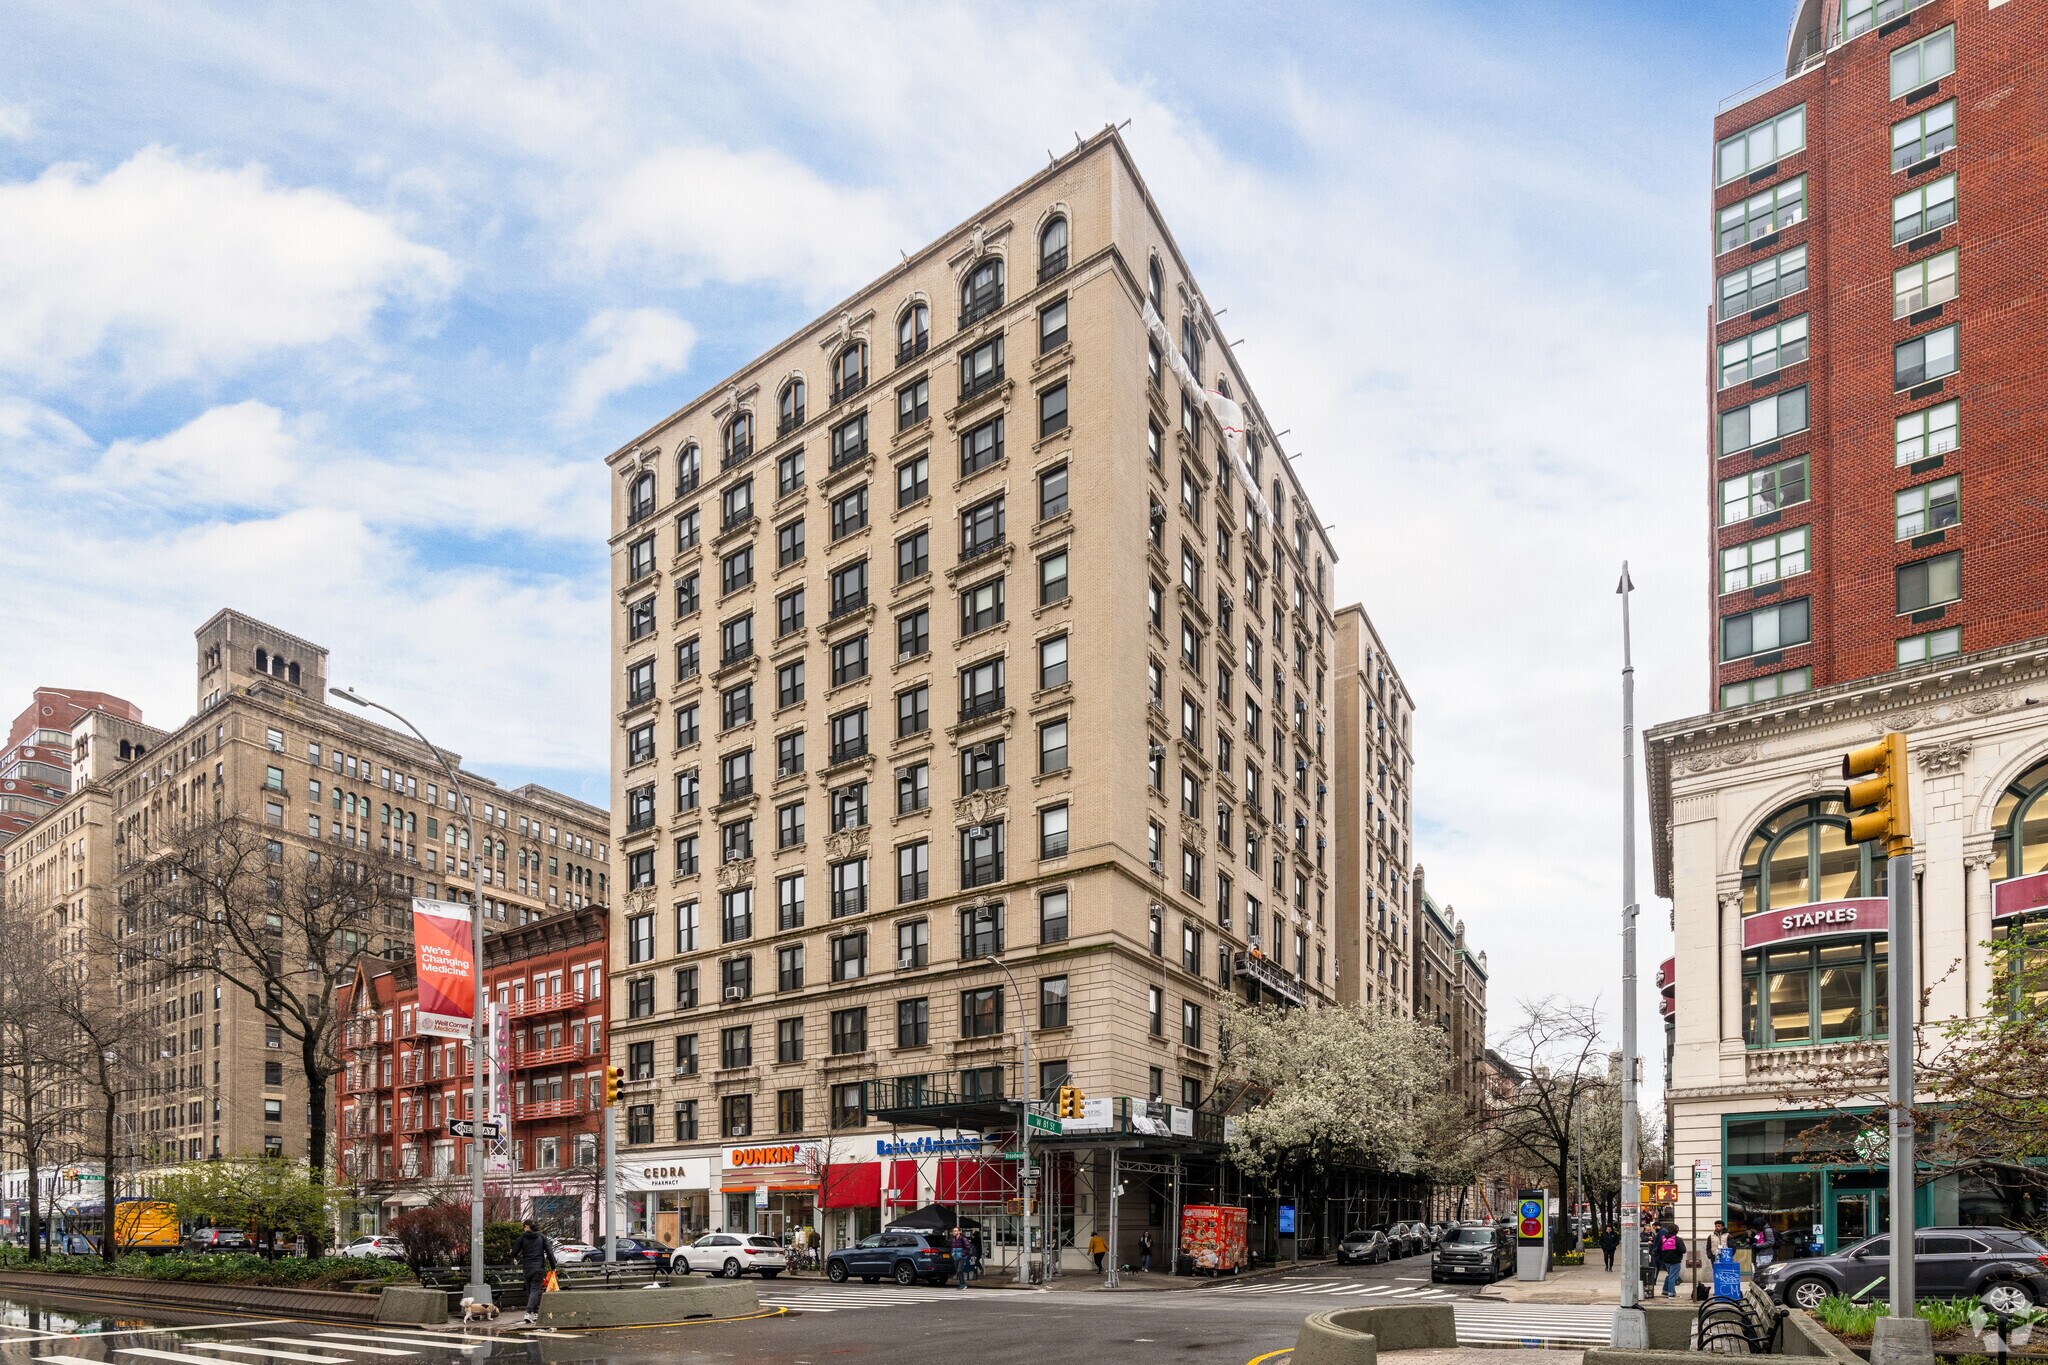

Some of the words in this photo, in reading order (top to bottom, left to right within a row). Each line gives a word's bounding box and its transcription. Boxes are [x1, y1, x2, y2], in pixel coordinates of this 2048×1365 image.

[1782, 908, 1858, 930] STAPLES
[420, 944, 451, 956] We're
[421, 953, 470, 969] Changing
[421, 962, 469, 977] Medicine.
[433, 1025, 460, 1034] Medicine
[434, 1019, 448, 1028] Weill
[448, 1020, 469, 1030] Cornell
[496, 1011, 509, 1076] TOWN
[1036, 1118, 1042, 1127] W
[1042, 1120, 1049, 1129] 81
[1049, 1122, 1055, 1131] St
[876, 1138, 909, 1156] Bank
[909, 1136, 924, 1153] of
[732, 1144, 799, 1166] DUNKIN'
[644, 1166, 686, 1179] CEDRA
[1671, 1188, 1677, 1200] 5
[1719, 1284, 1740, 1297] CM
